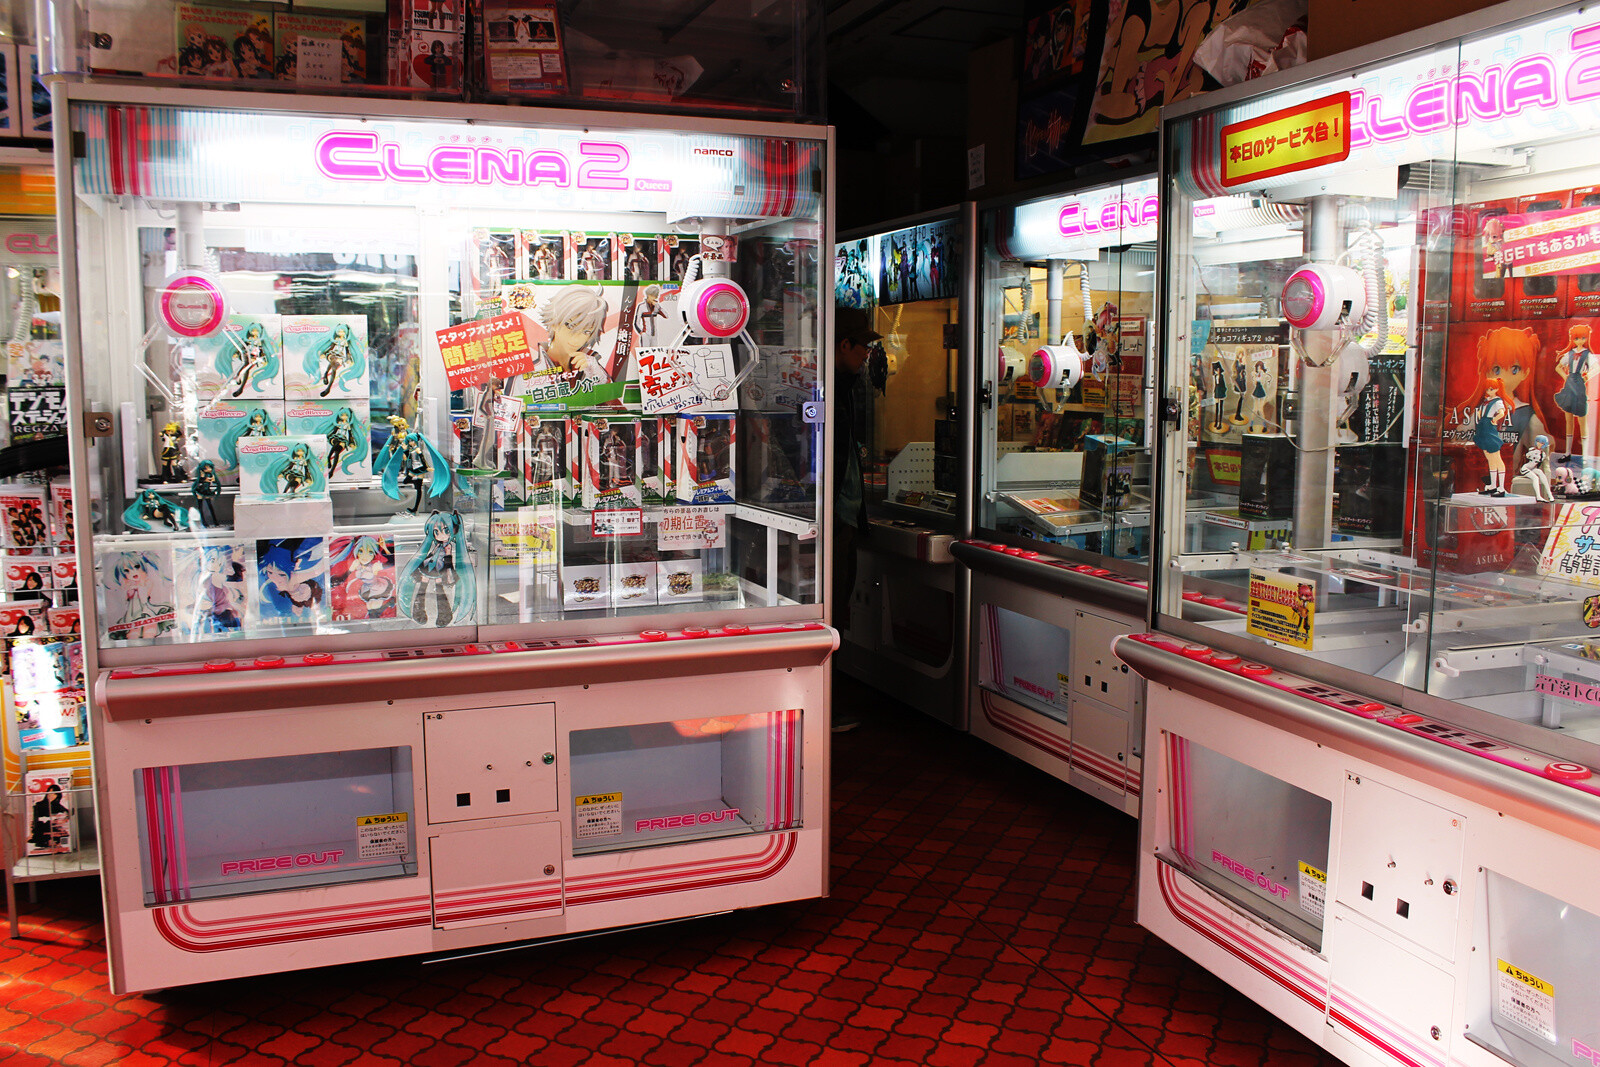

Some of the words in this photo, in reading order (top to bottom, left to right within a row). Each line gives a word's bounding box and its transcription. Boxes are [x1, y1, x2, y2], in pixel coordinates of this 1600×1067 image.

[1230, 117, 1340, 164] 本日のサービス台！
[694, 147, 734, 157] namco
[637, 179, 671, 191] Queen
[1194, 207, 1215, 217] Queen
[438, 316, 521, 344] スタッフオススメ！
[442, 330, 527, 369] 簡単設定
[13, 425, 60, 433] REGZA
[1475, 554, 1504, 565] ASUKA
[1014, 676, 1037, 694] PRIZE
[373, 815, 399, 823] ちゅうい
[635, 814, 695, 833] PRIZE
[698, 809, 740, 825] OUT
[221, 855, 292, 876] PRIZE
[294, 850, 345, 866] OUT
[1211, 849, 1256, 885] PRIZE
[1256, 874, 1290, 901] OUT
[1515, 970, 1544, 990] ちゅうい
